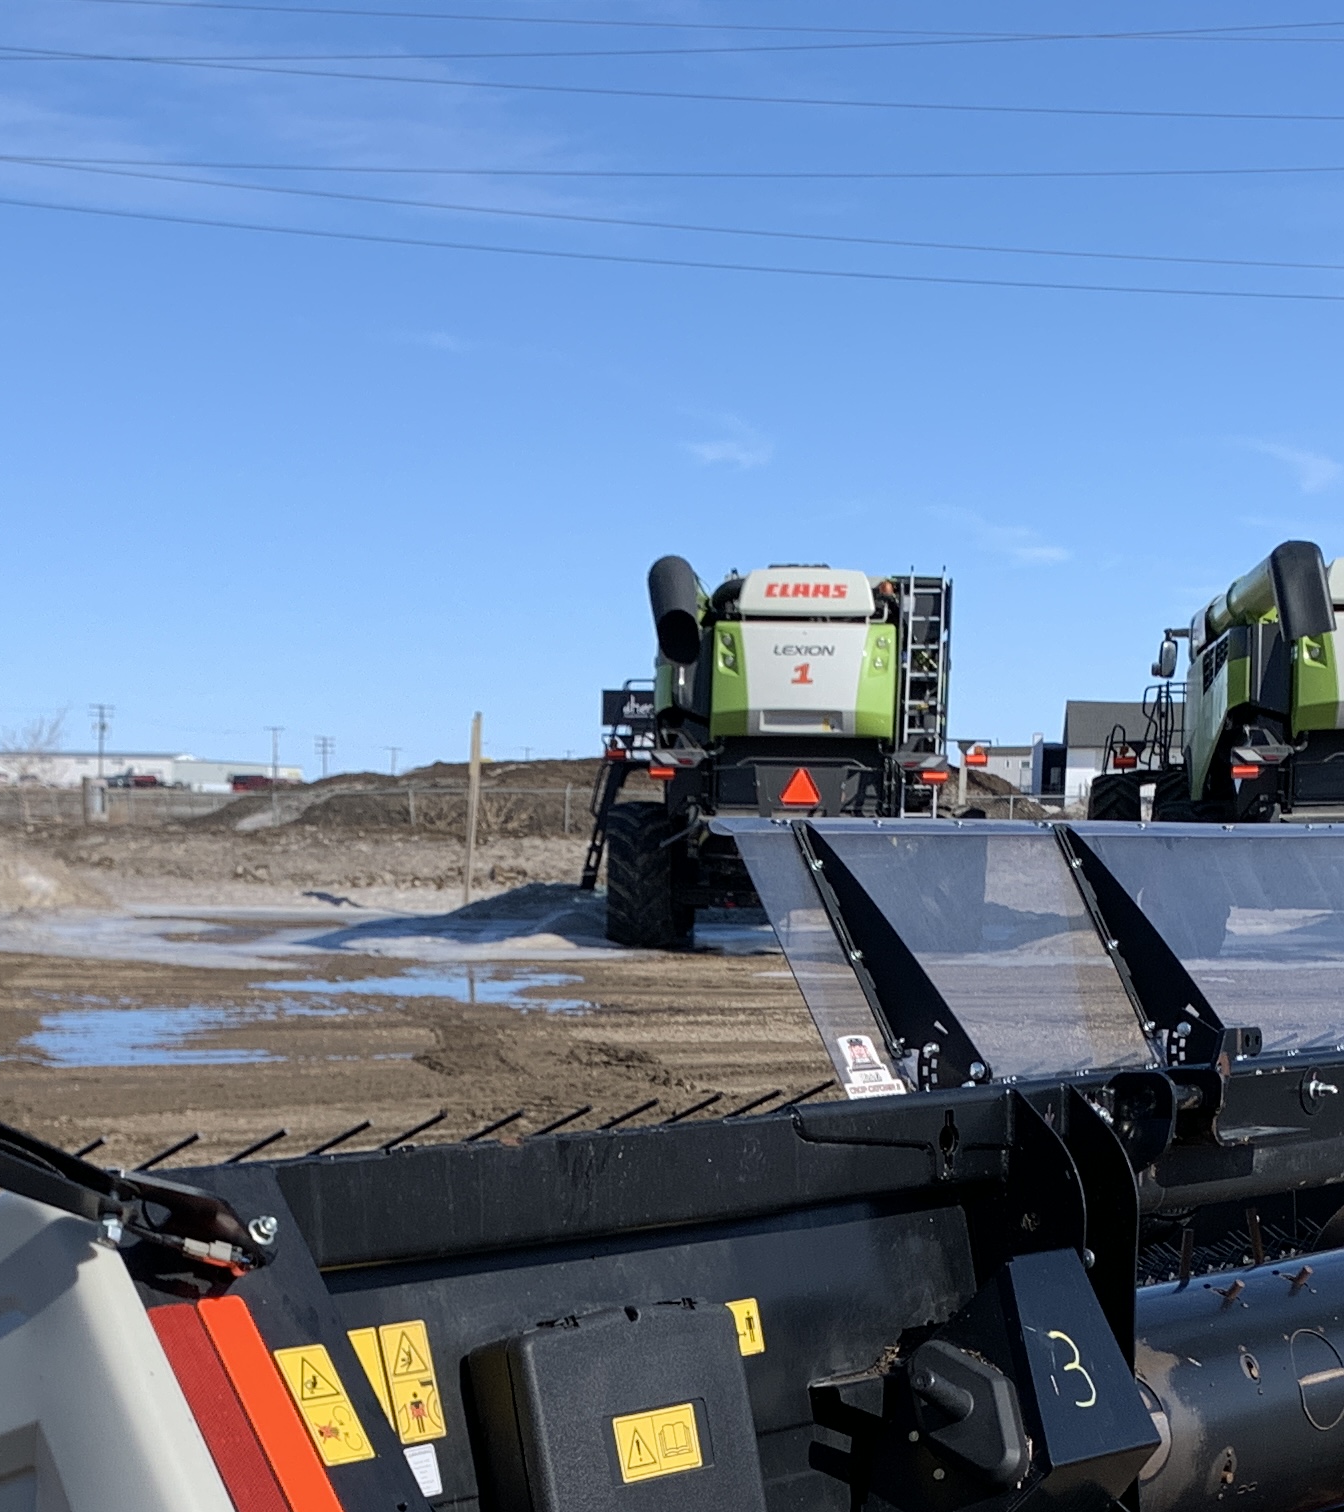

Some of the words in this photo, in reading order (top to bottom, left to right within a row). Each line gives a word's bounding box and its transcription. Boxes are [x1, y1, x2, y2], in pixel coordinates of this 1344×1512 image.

[764, 583, 848, 599] CLAAS
[773, 644, 836, 657] LEXION
[791, 663, 813, 684] 1
[1047, 1330, 1097, 1408] 3
